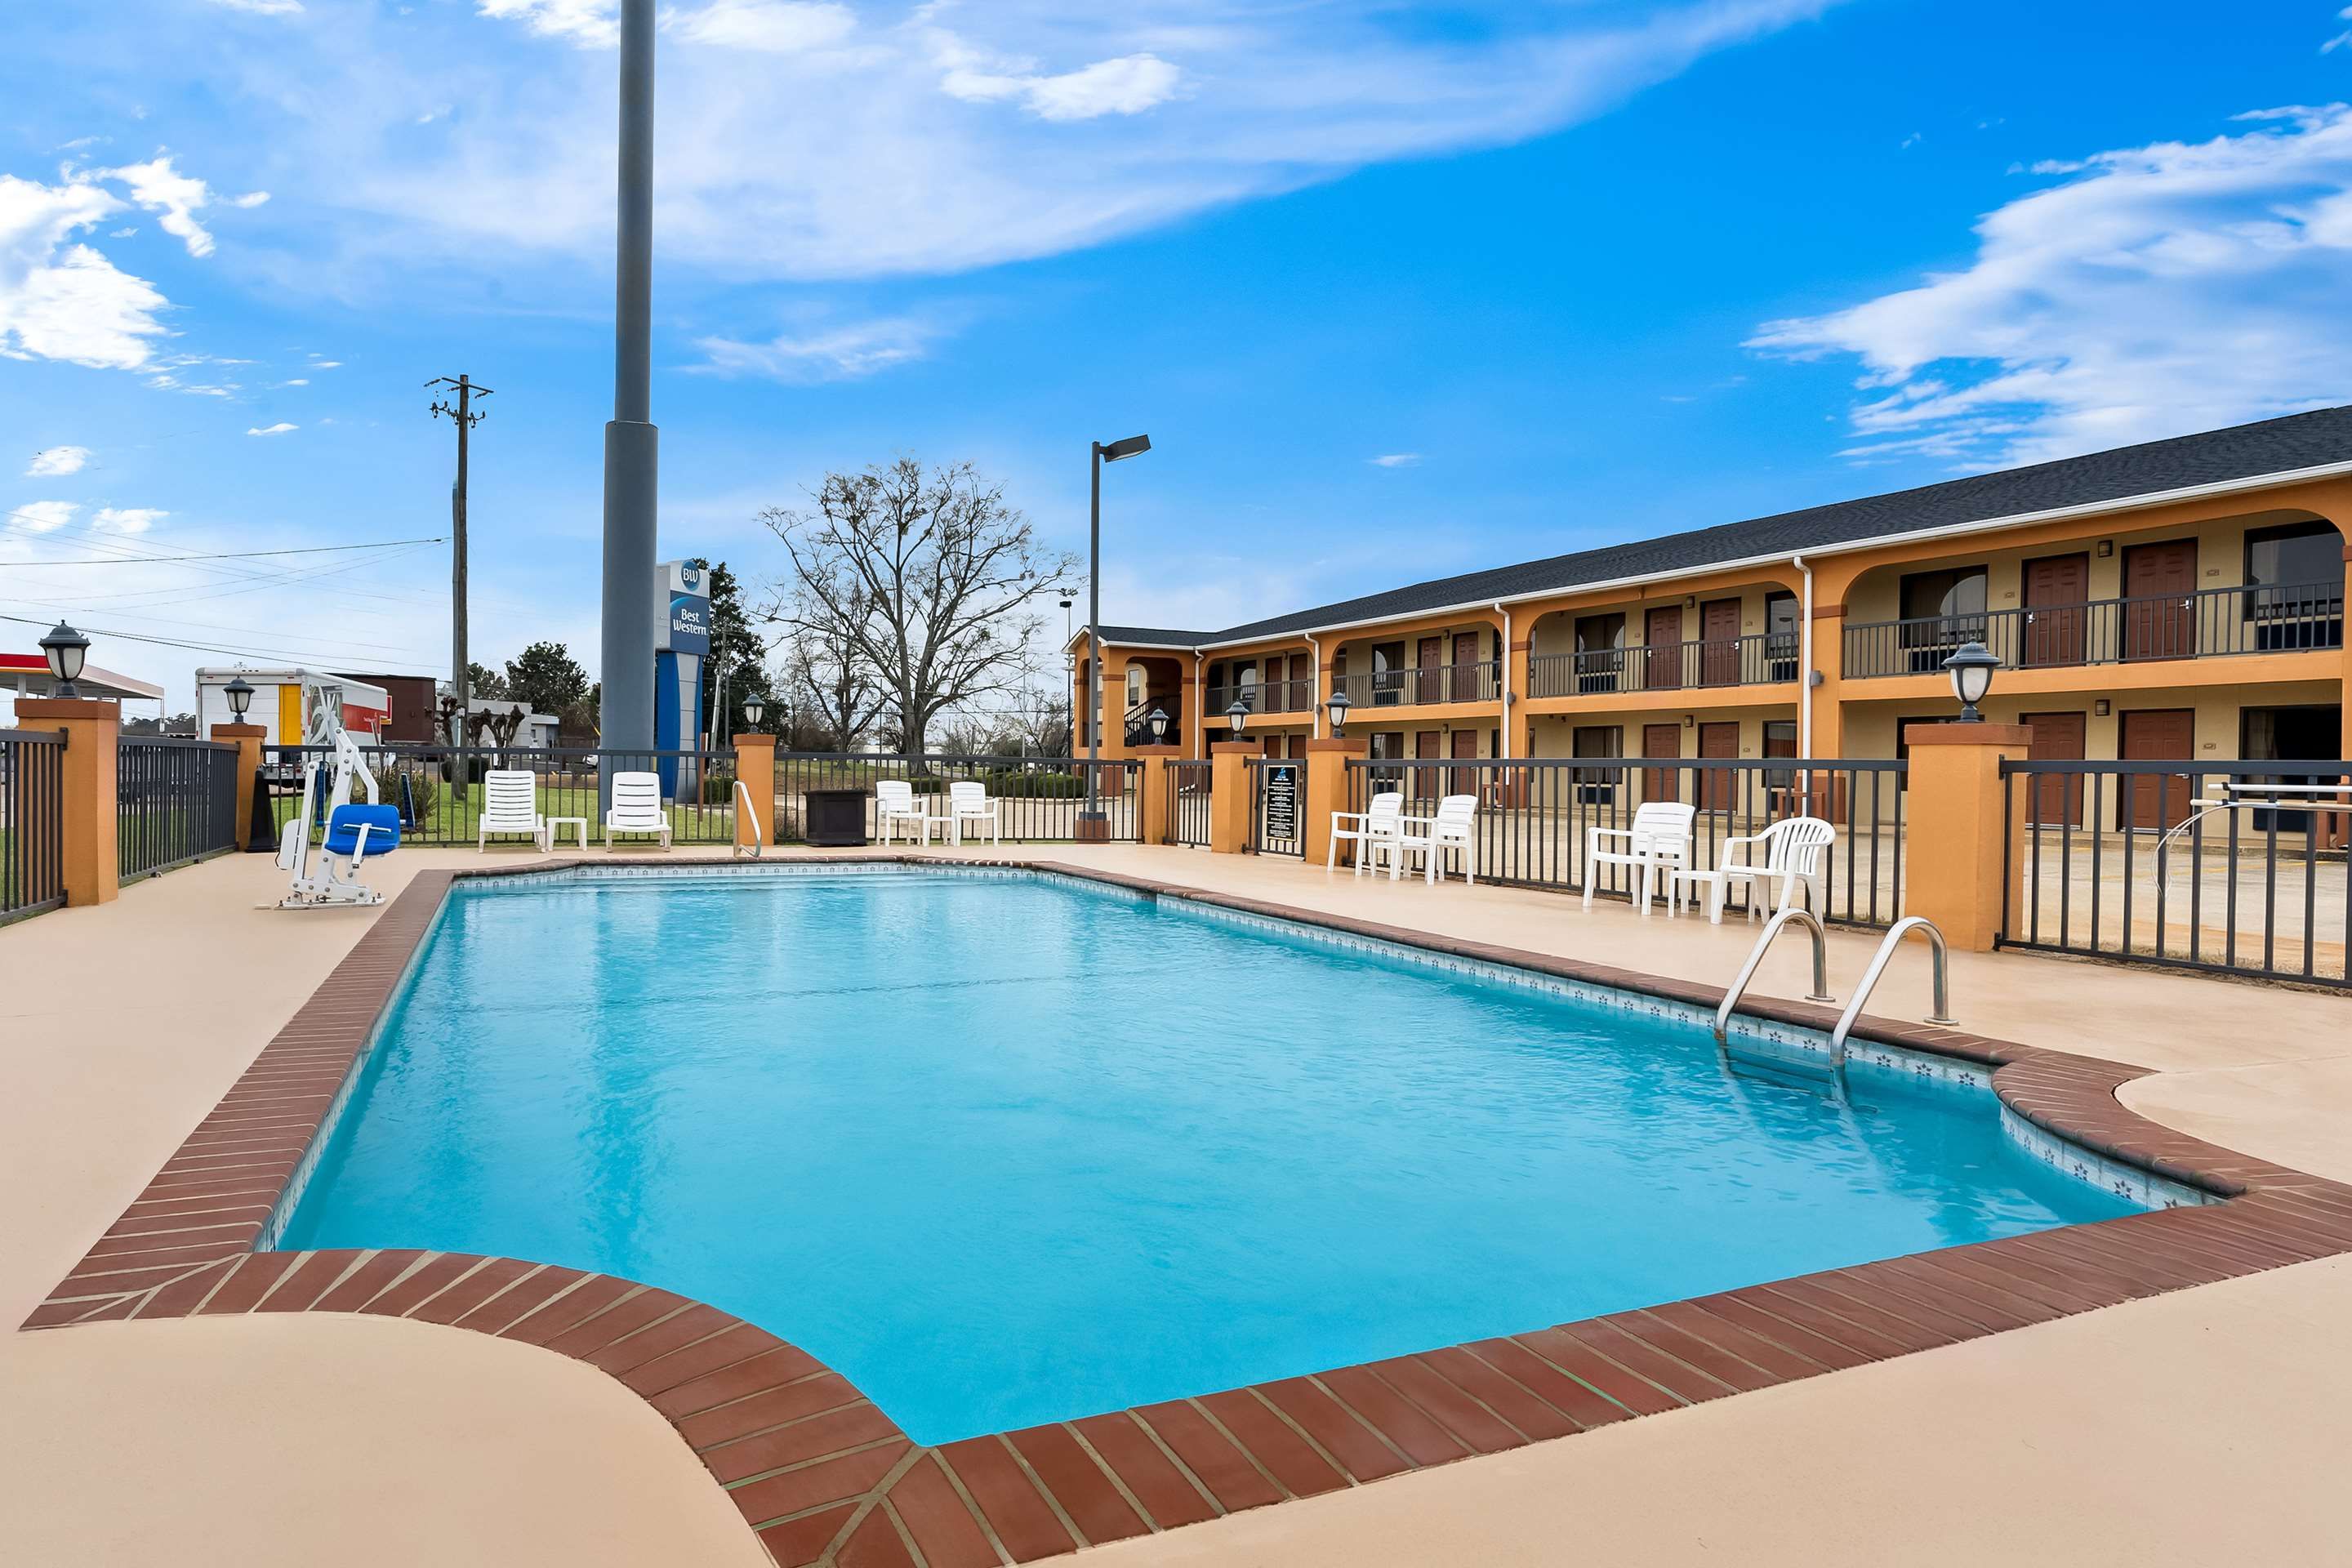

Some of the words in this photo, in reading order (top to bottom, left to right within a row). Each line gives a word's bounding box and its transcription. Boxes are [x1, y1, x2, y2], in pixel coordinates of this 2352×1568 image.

[683, 568, 698, 582] BW
[681, 608, 700, 623] Best
[673, 618, 706, 635] Western
